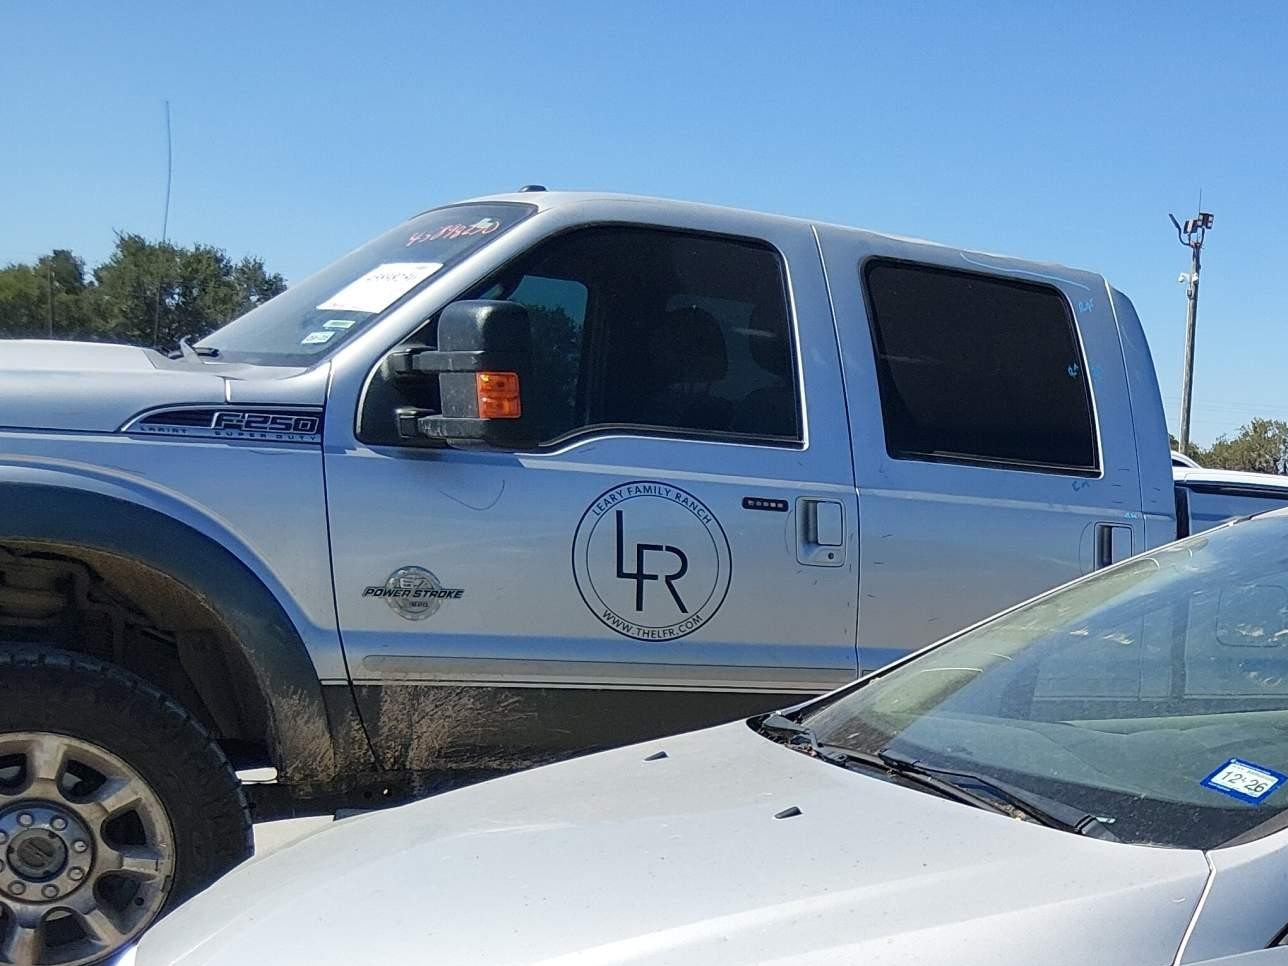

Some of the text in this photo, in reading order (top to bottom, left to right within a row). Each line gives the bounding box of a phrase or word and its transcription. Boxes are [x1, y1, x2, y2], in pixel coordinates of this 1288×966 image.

[211, 411, 320, 434] F-250
[214, 430, 317, 442] SUPER DUTY
[592, 484, 713, 525] LEARY FAMILY RANCH
[616, 510, 689, 614] LFR
[362, 587, 464, 599] POWER STROKE
[602, 609, 703, 639] WWW.THELFR.COM
[1244, 778, 1269, 793] 26
